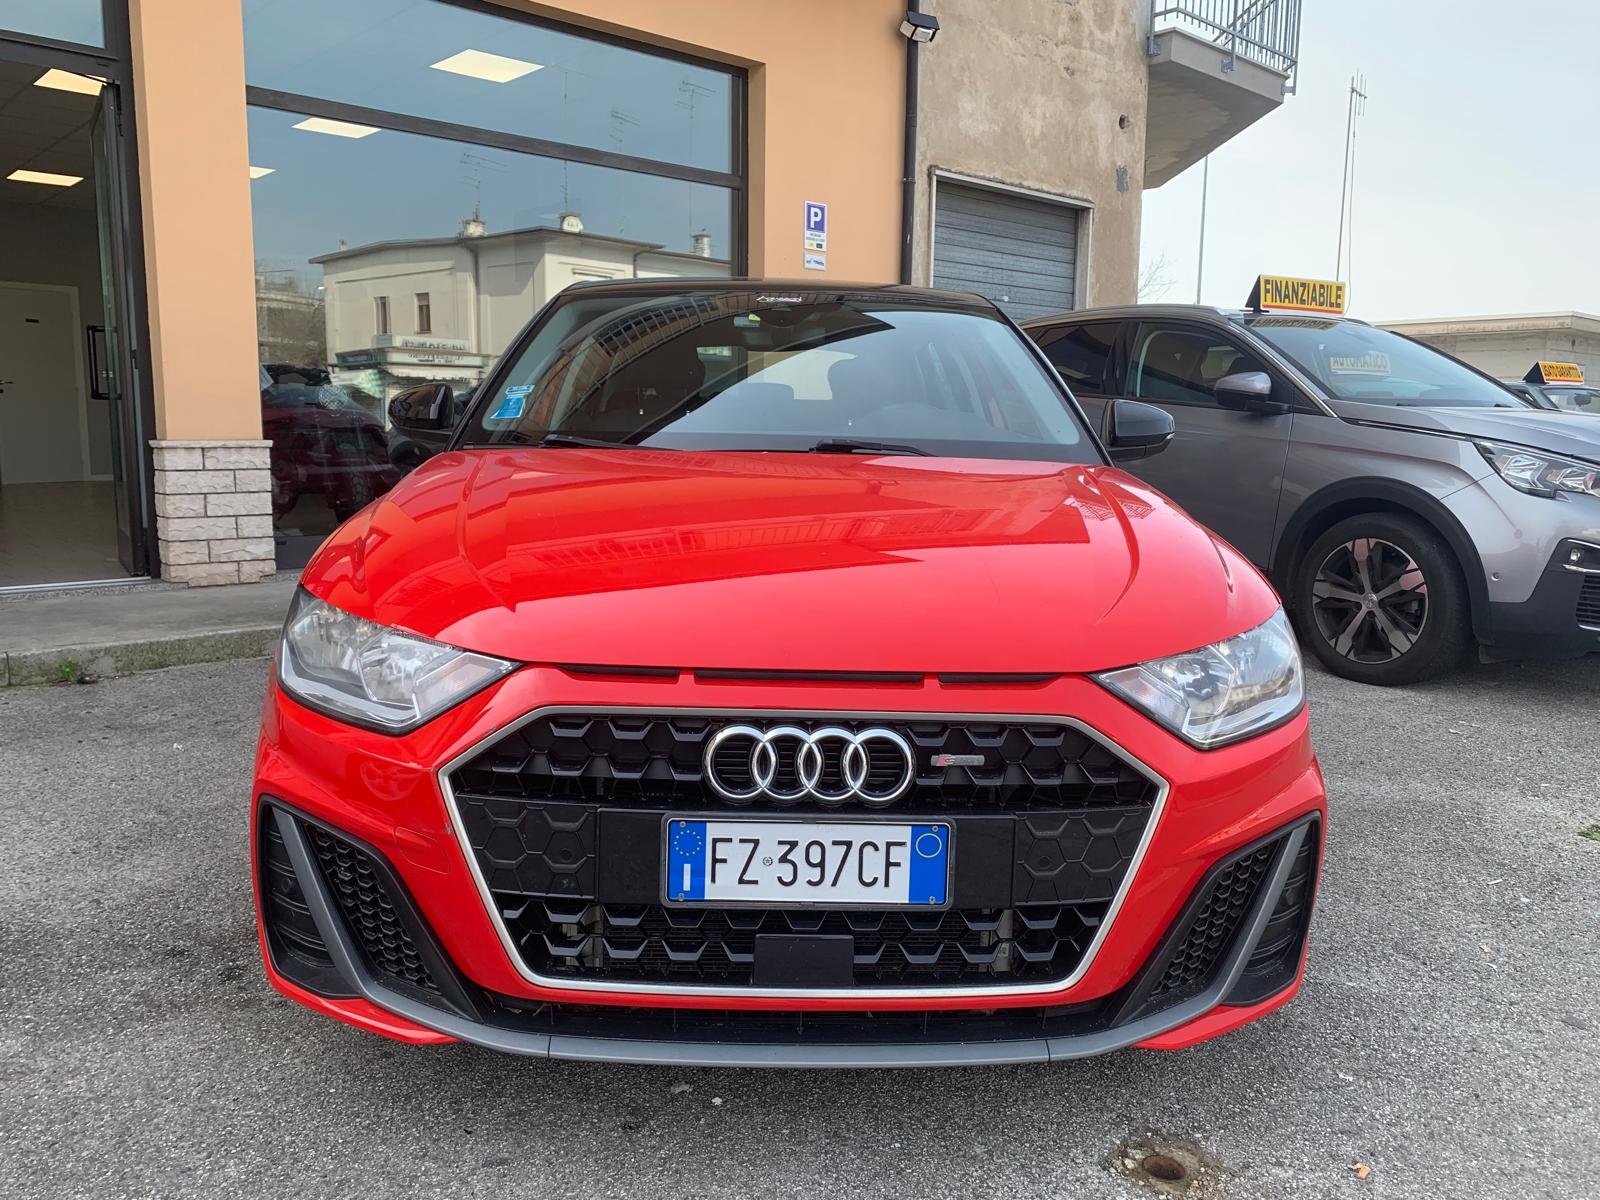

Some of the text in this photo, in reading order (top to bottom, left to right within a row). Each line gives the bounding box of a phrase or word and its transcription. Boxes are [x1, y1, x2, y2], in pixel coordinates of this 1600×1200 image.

[810, 206, 822, 228] P
[1263, 278, 1343, 309] FINANZIABILE
[1332, 352, 1388, 370] AUTOMATICO
